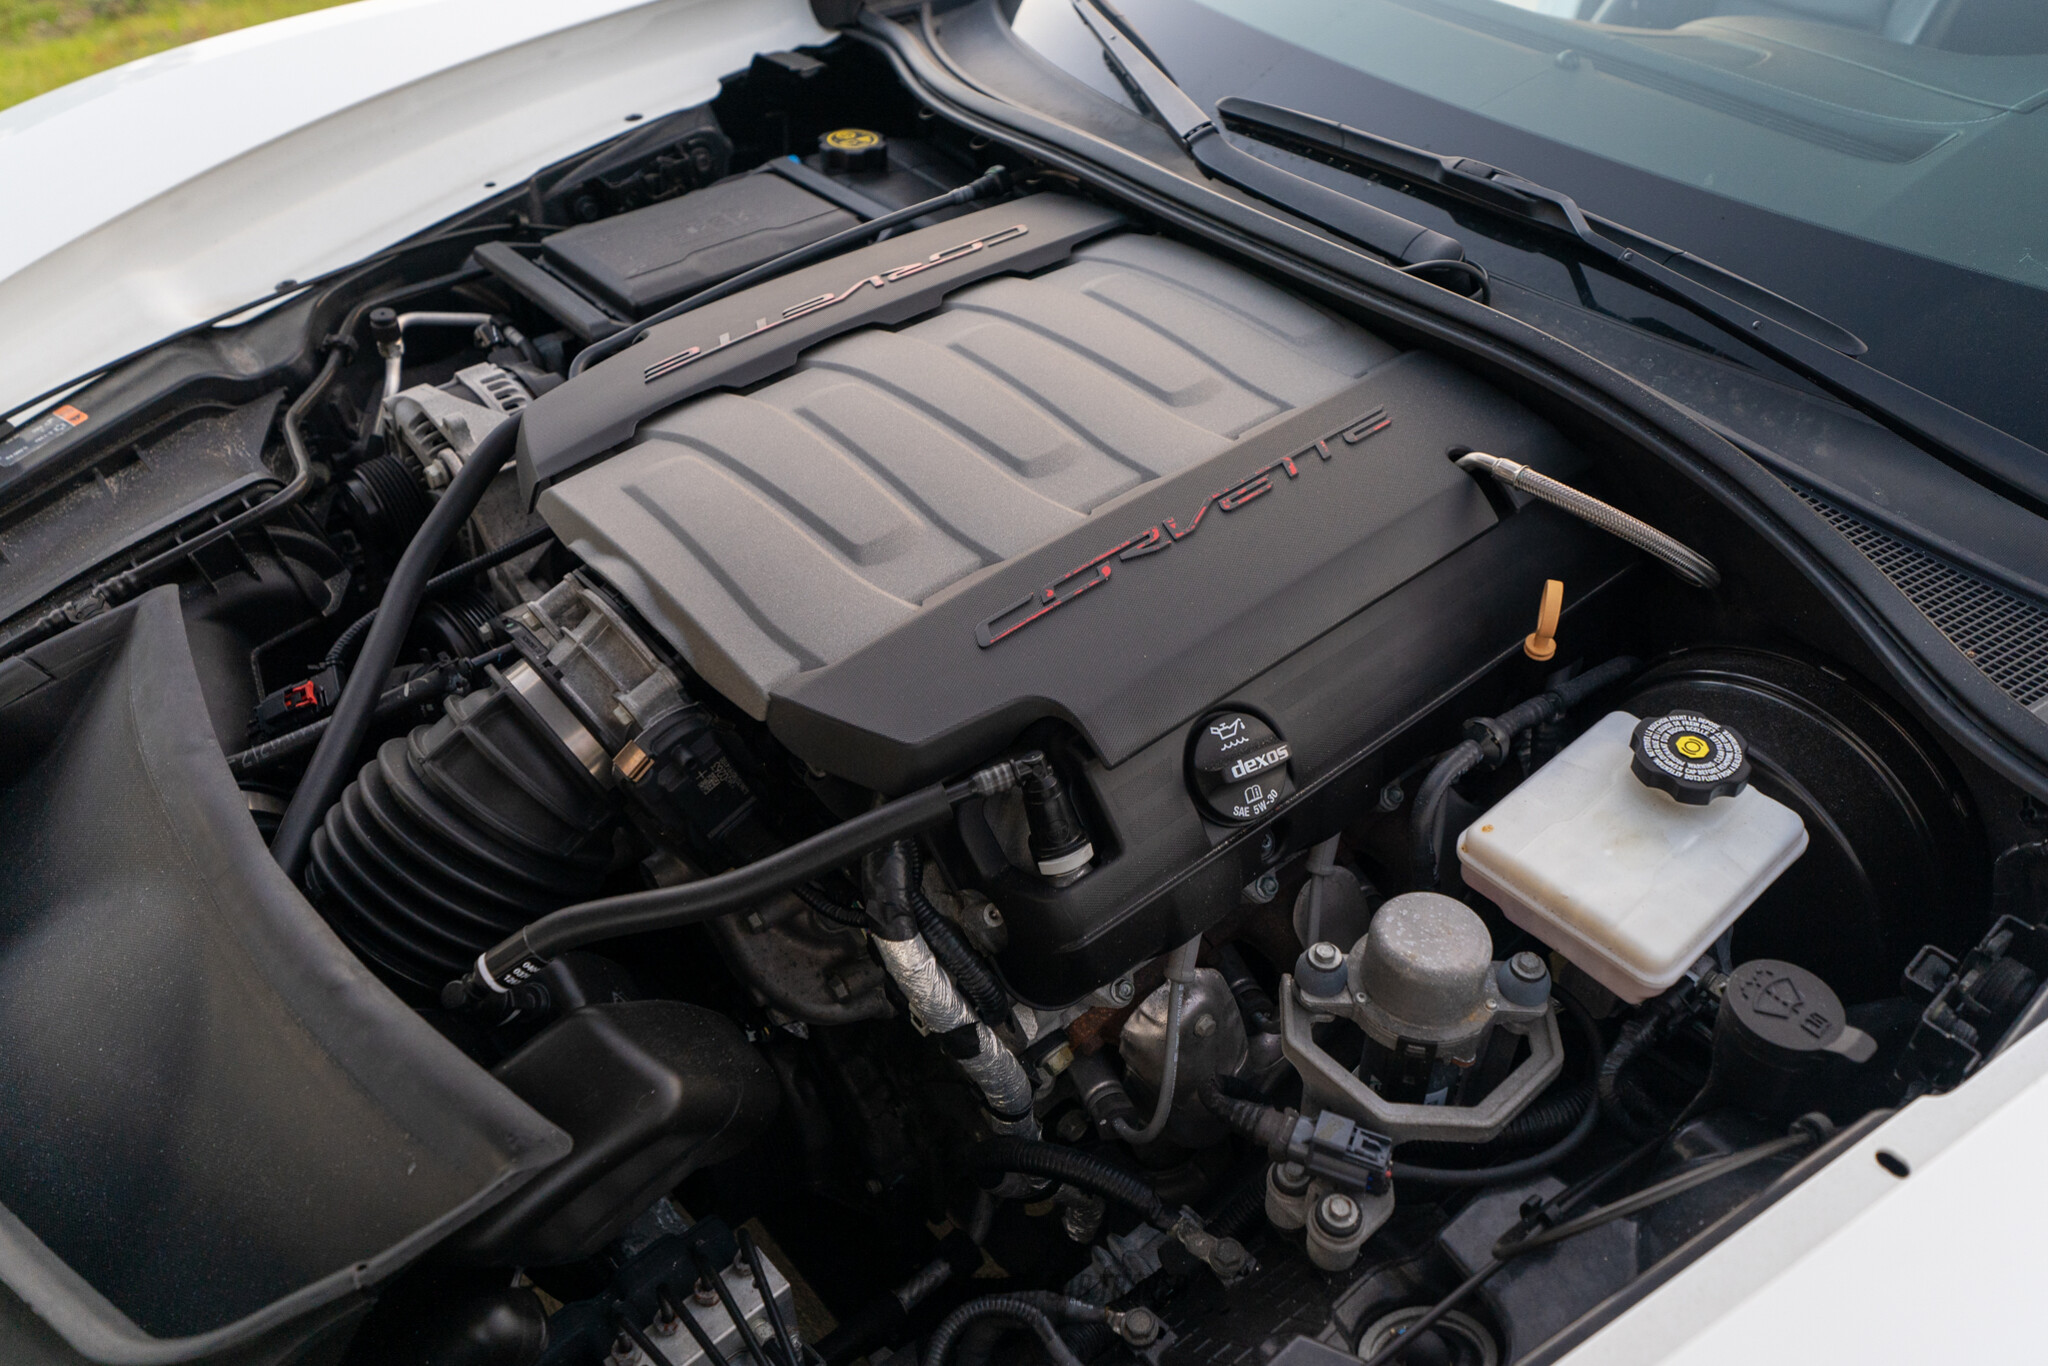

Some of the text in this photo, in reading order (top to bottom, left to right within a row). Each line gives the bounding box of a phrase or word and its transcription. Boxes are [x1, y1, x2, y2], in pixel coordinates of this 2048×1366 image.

[645, 224, 1028, 384] CORVETTE
[975, 404, 1392, 648] CORVETTE
[1231, 745, 1289, 778] dexos
[1233, 789, 1278, 817] SAE 5W-30
